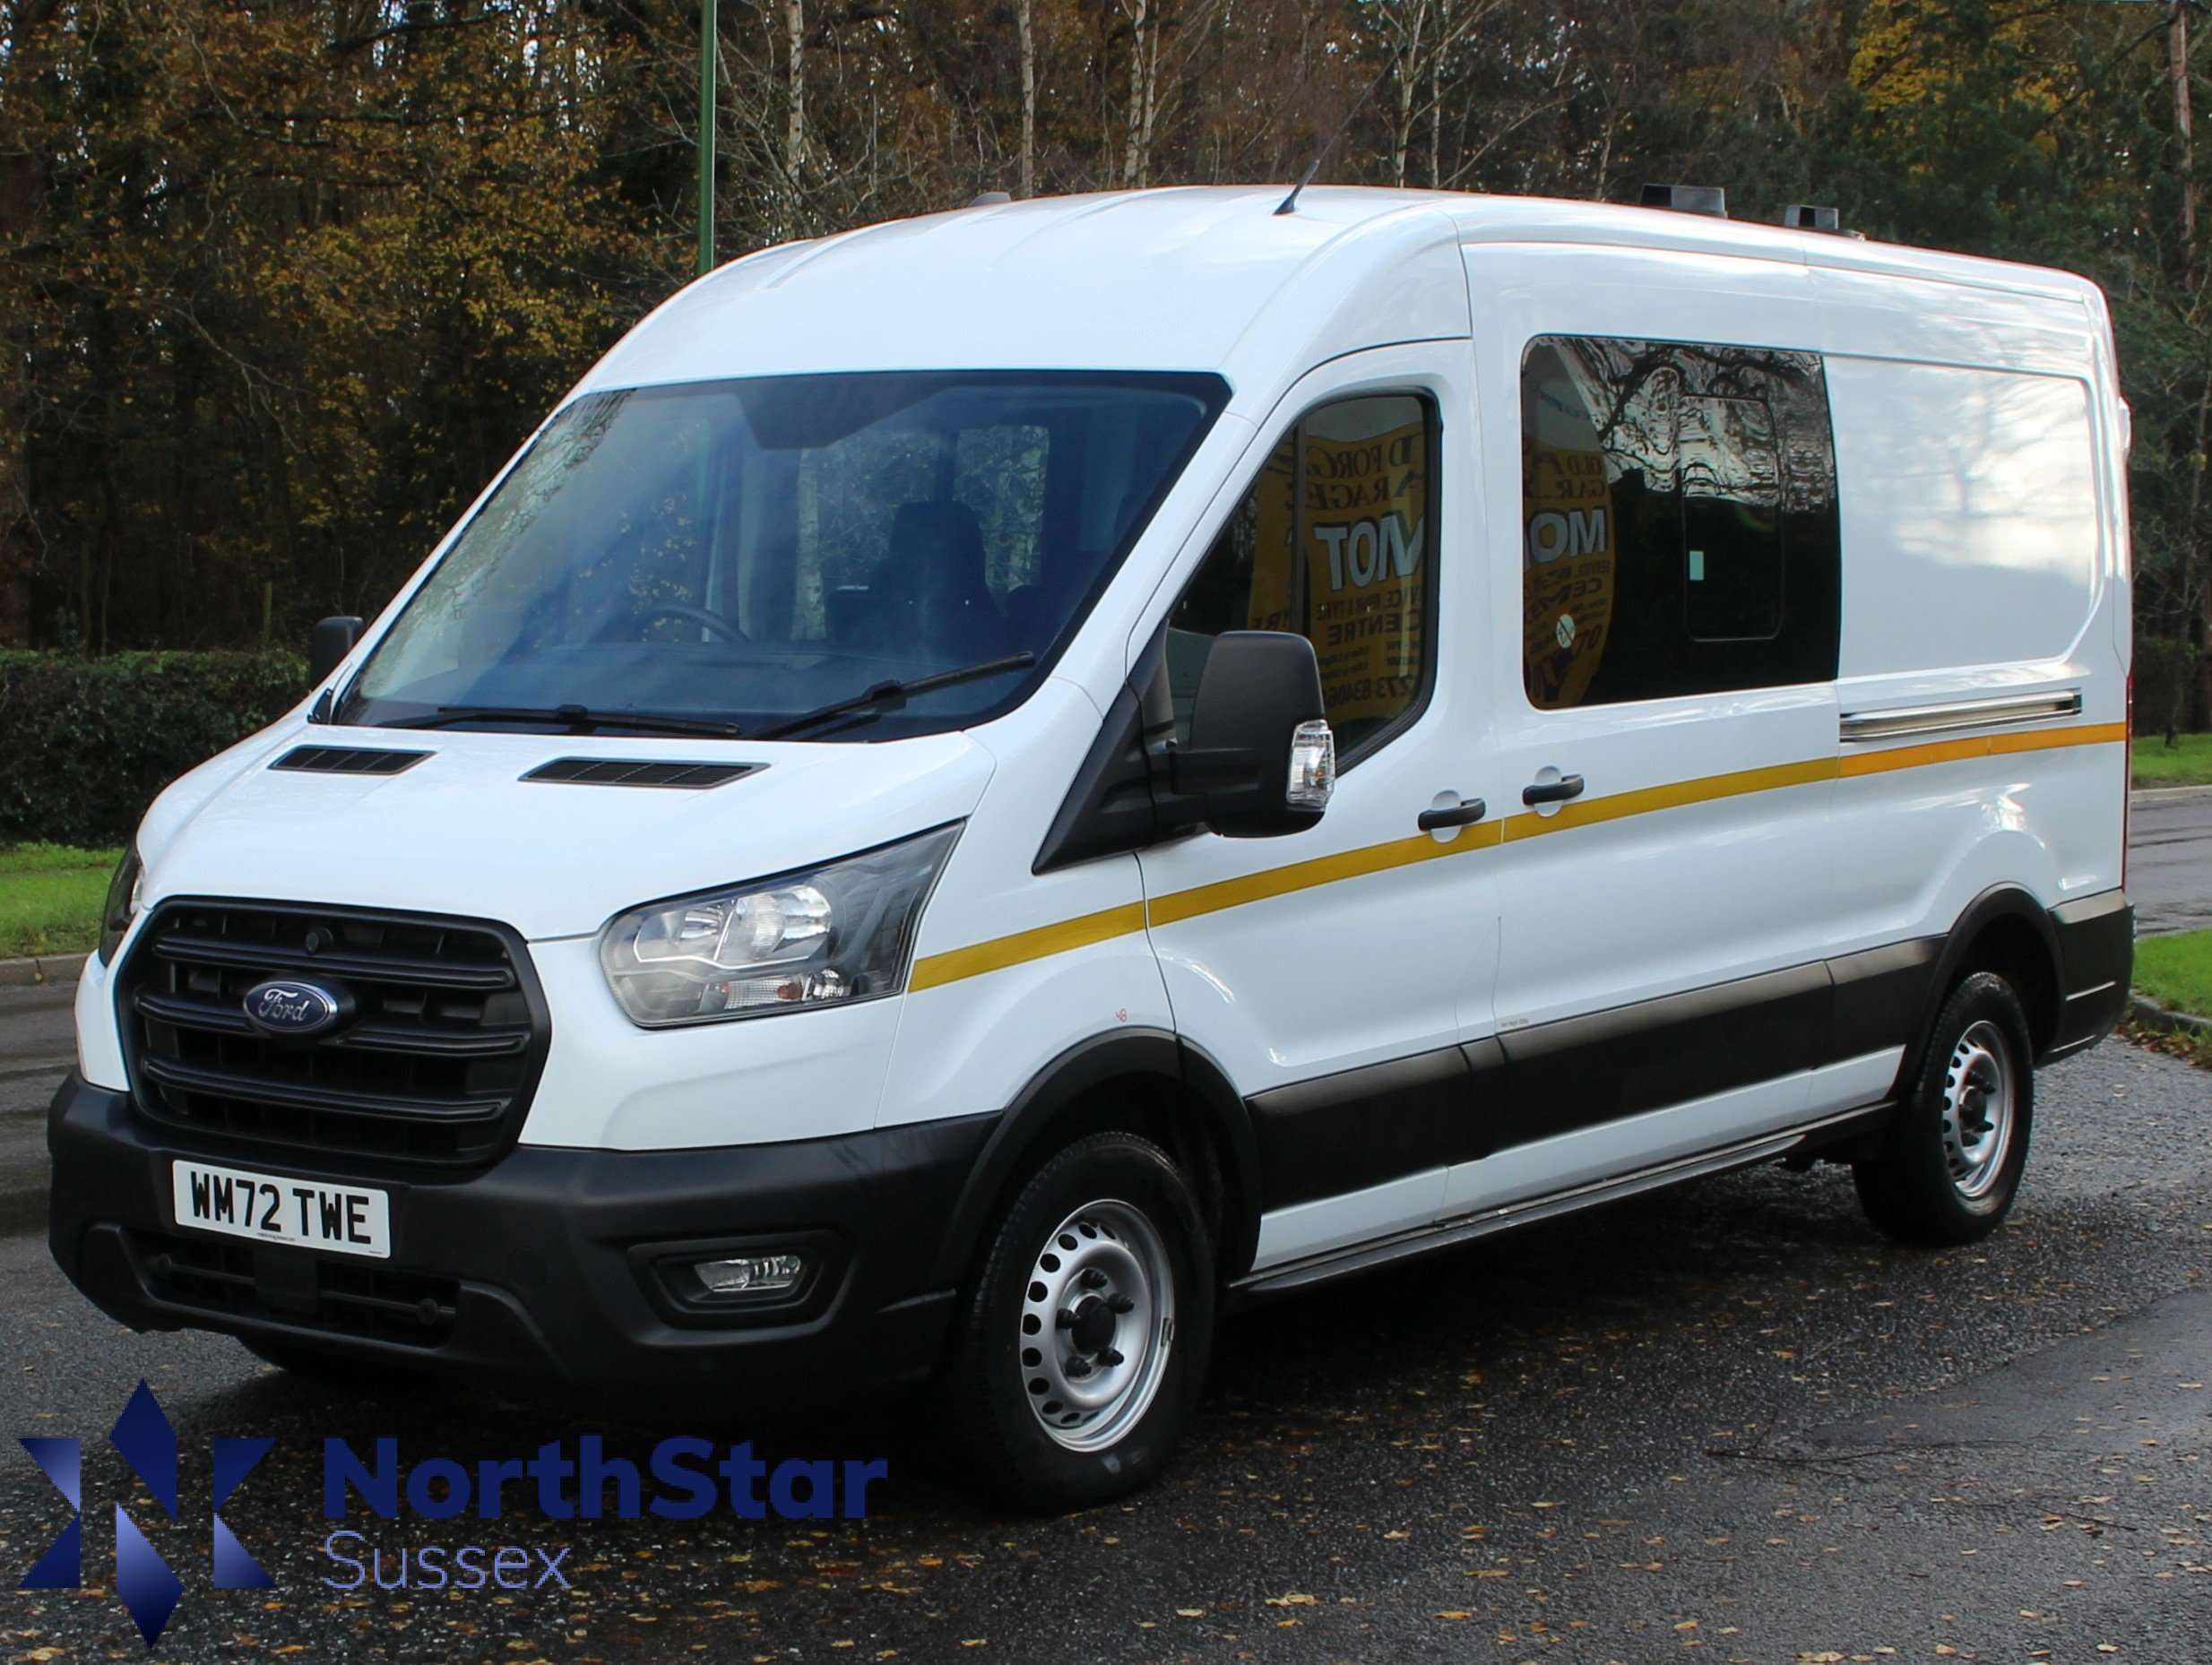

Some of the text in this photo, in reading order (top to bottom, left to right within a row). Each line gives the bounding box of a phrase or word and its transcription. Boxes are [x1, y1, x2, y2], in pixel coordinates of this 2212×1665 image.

[258, 988, 311, 1022] Ford
[191, 1171, 371, 1244] WM72 TWE
